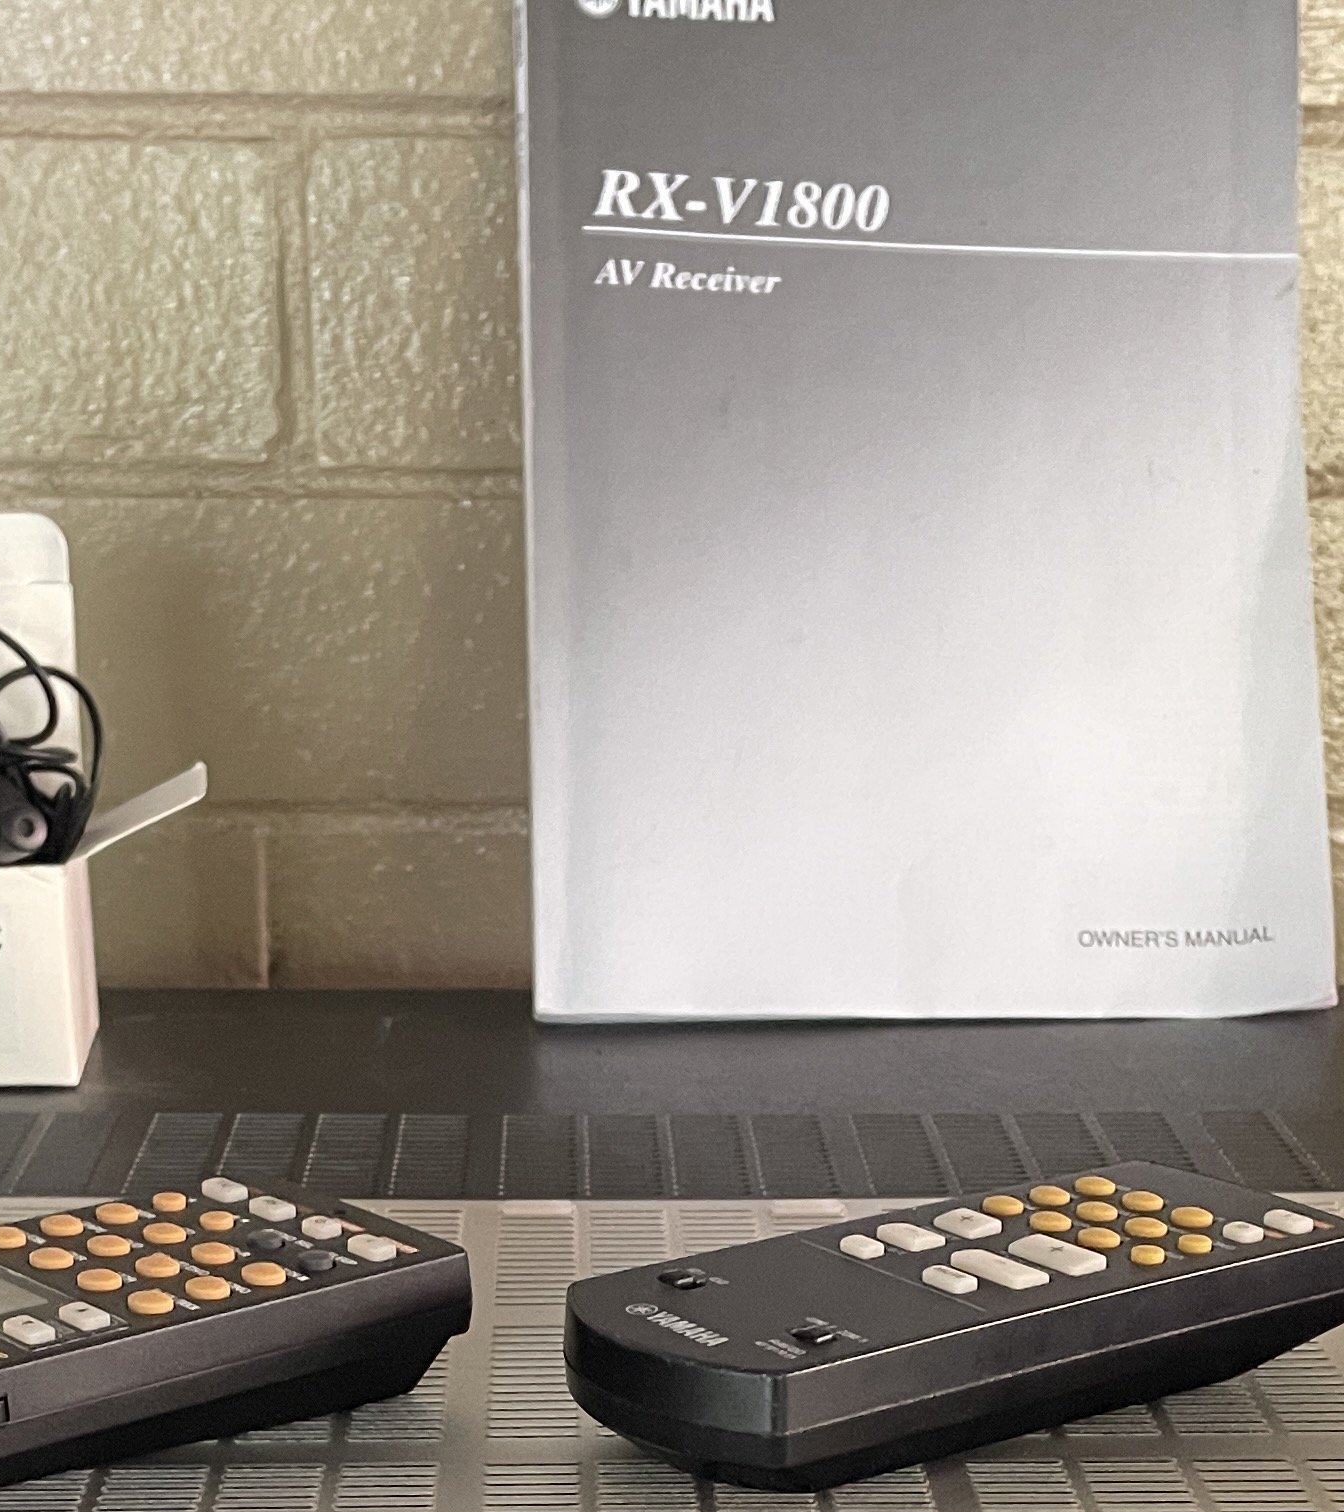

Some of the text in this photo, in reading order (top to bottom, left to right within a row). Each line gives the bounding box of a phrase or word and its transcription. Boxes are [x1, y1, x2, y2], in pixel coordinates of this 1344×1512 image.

[594, 169, 891, 232] RX-V1800
[594, 259, 782, 295] AV Receiver
[1078, 925, 1275, 948] OWNER'S MANUAL
[647, 1311, 729, 1347] YAMAHA
